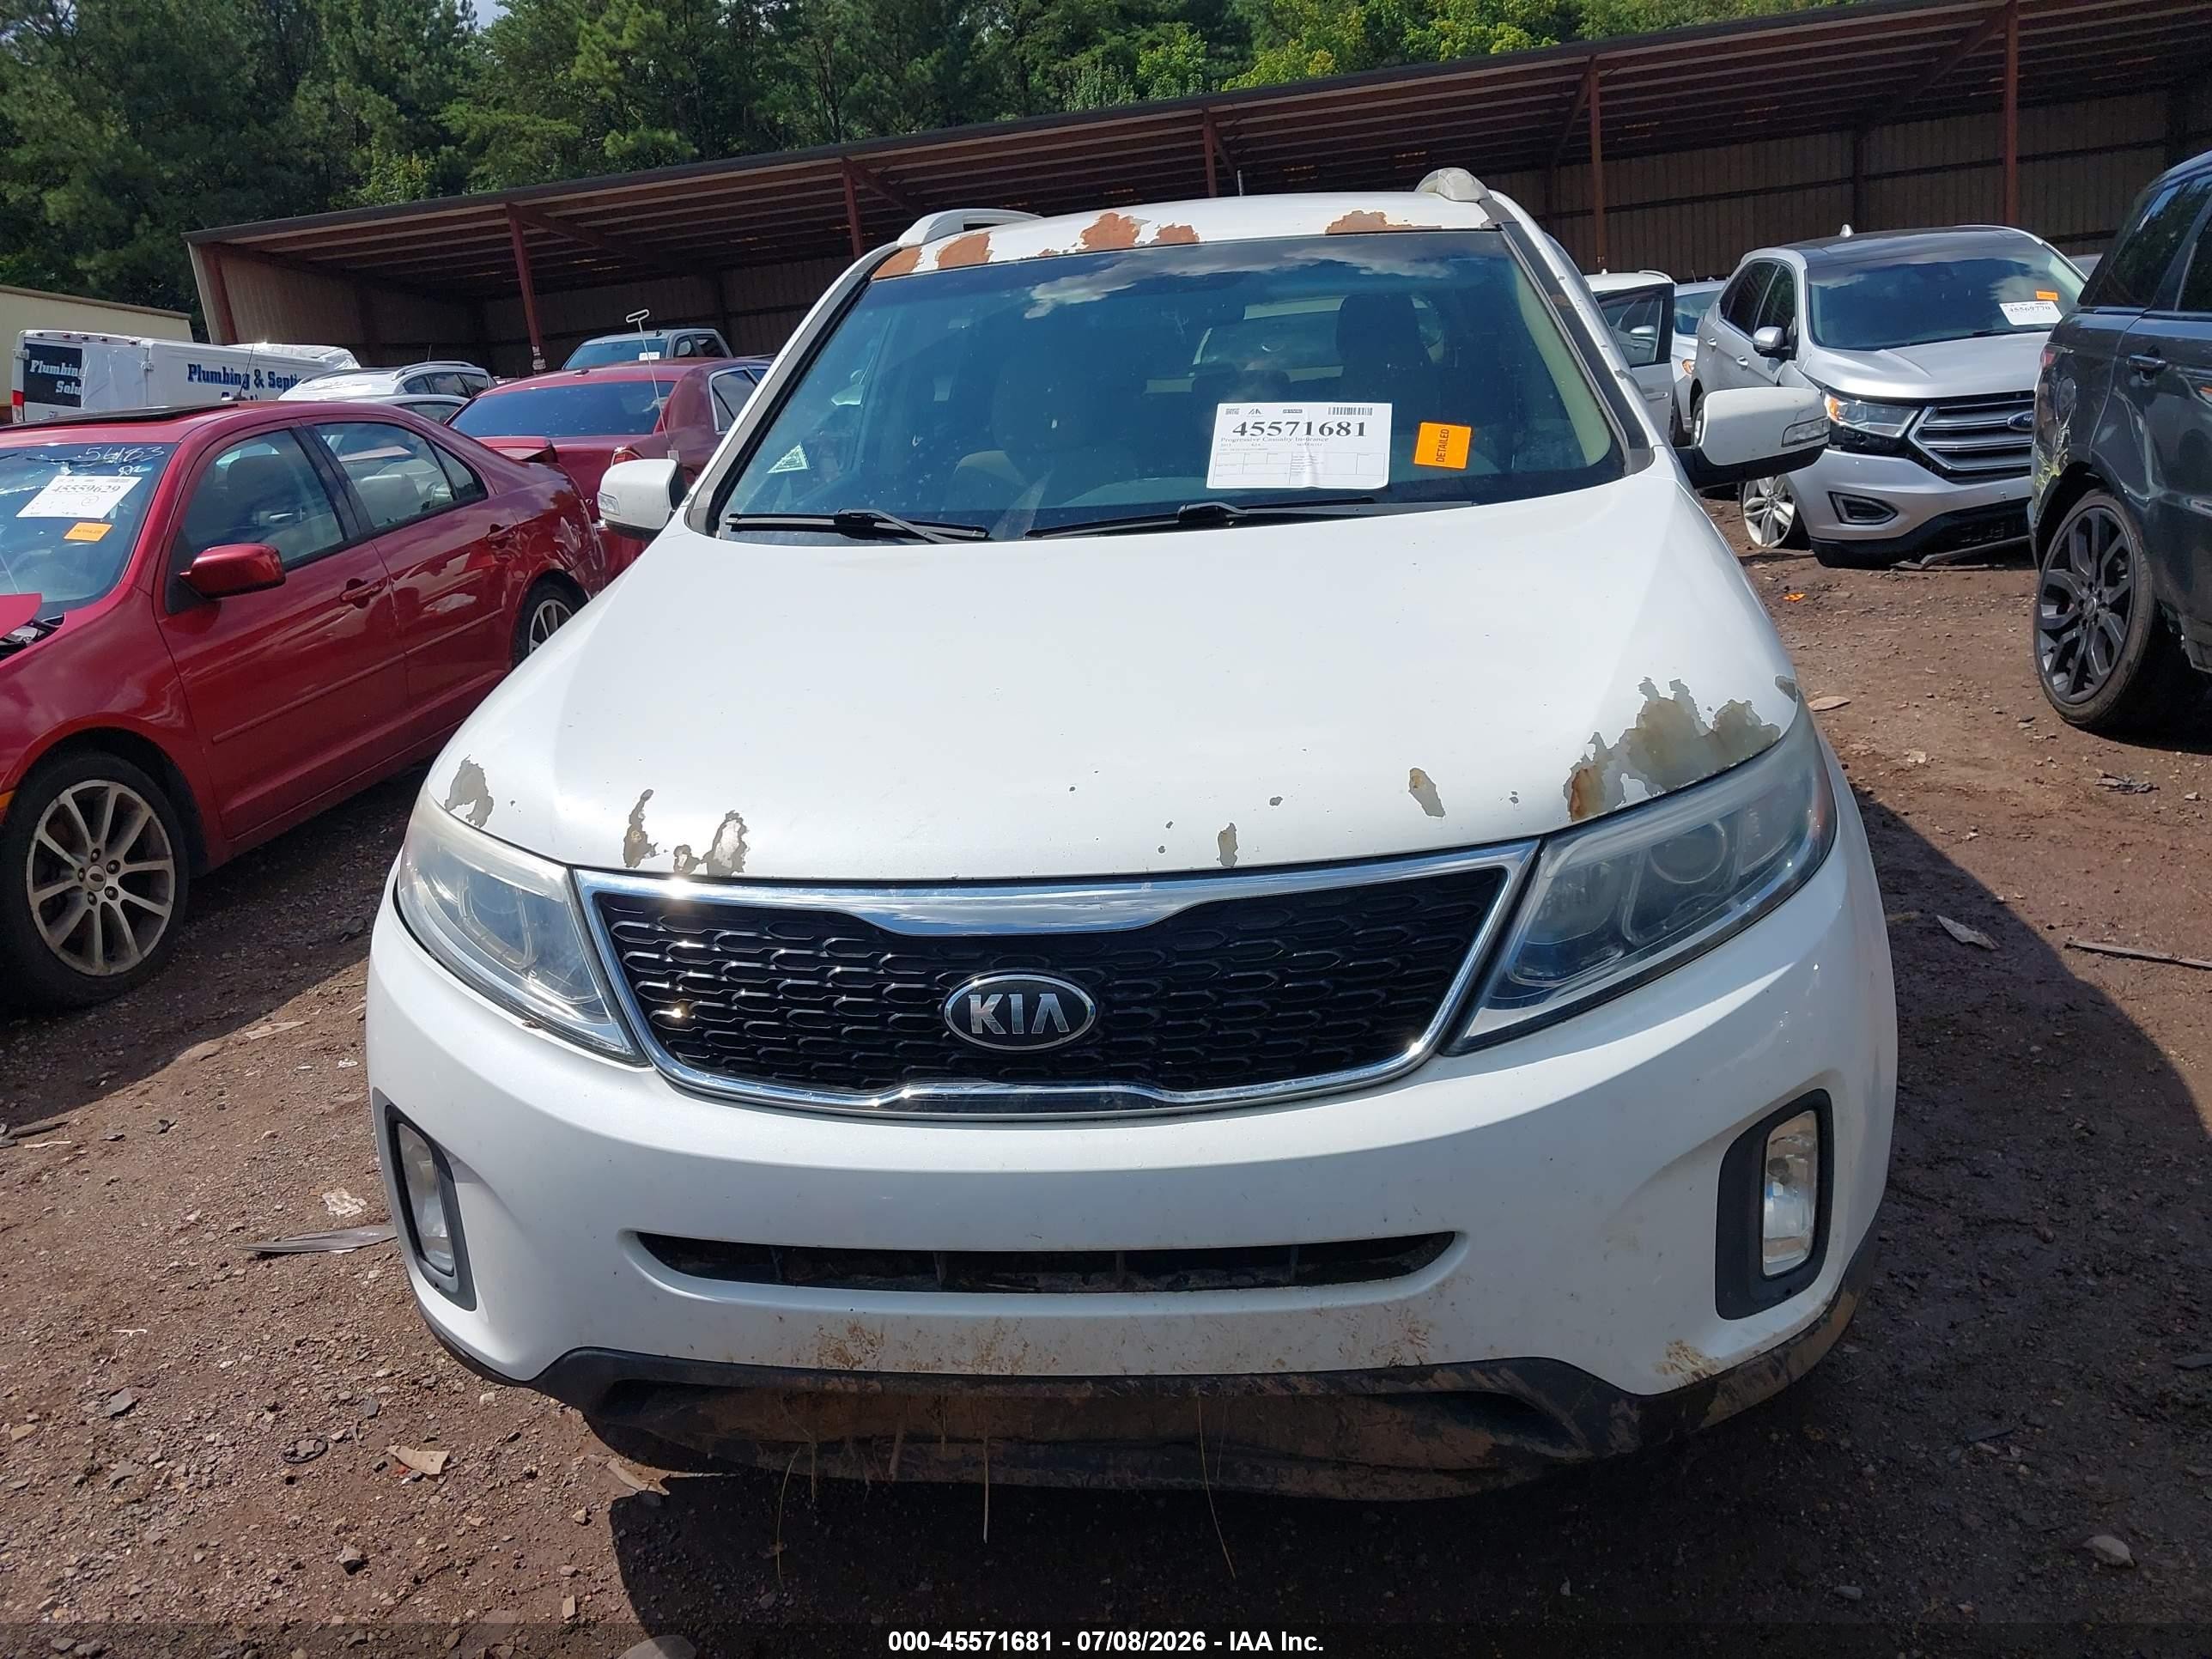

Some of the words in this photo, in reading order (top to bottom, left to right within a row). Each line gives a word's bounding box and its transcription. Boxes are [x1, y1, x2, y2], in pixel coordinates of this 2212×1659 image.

[187, 364, 250, 391] Plumbing
[254, 369, 264, 388] &
[1232, 421, 1367, 437] 45571681
[1436, 428, 1449, 462] DETAILED
[968, 994, 1070, 1035] KIA
